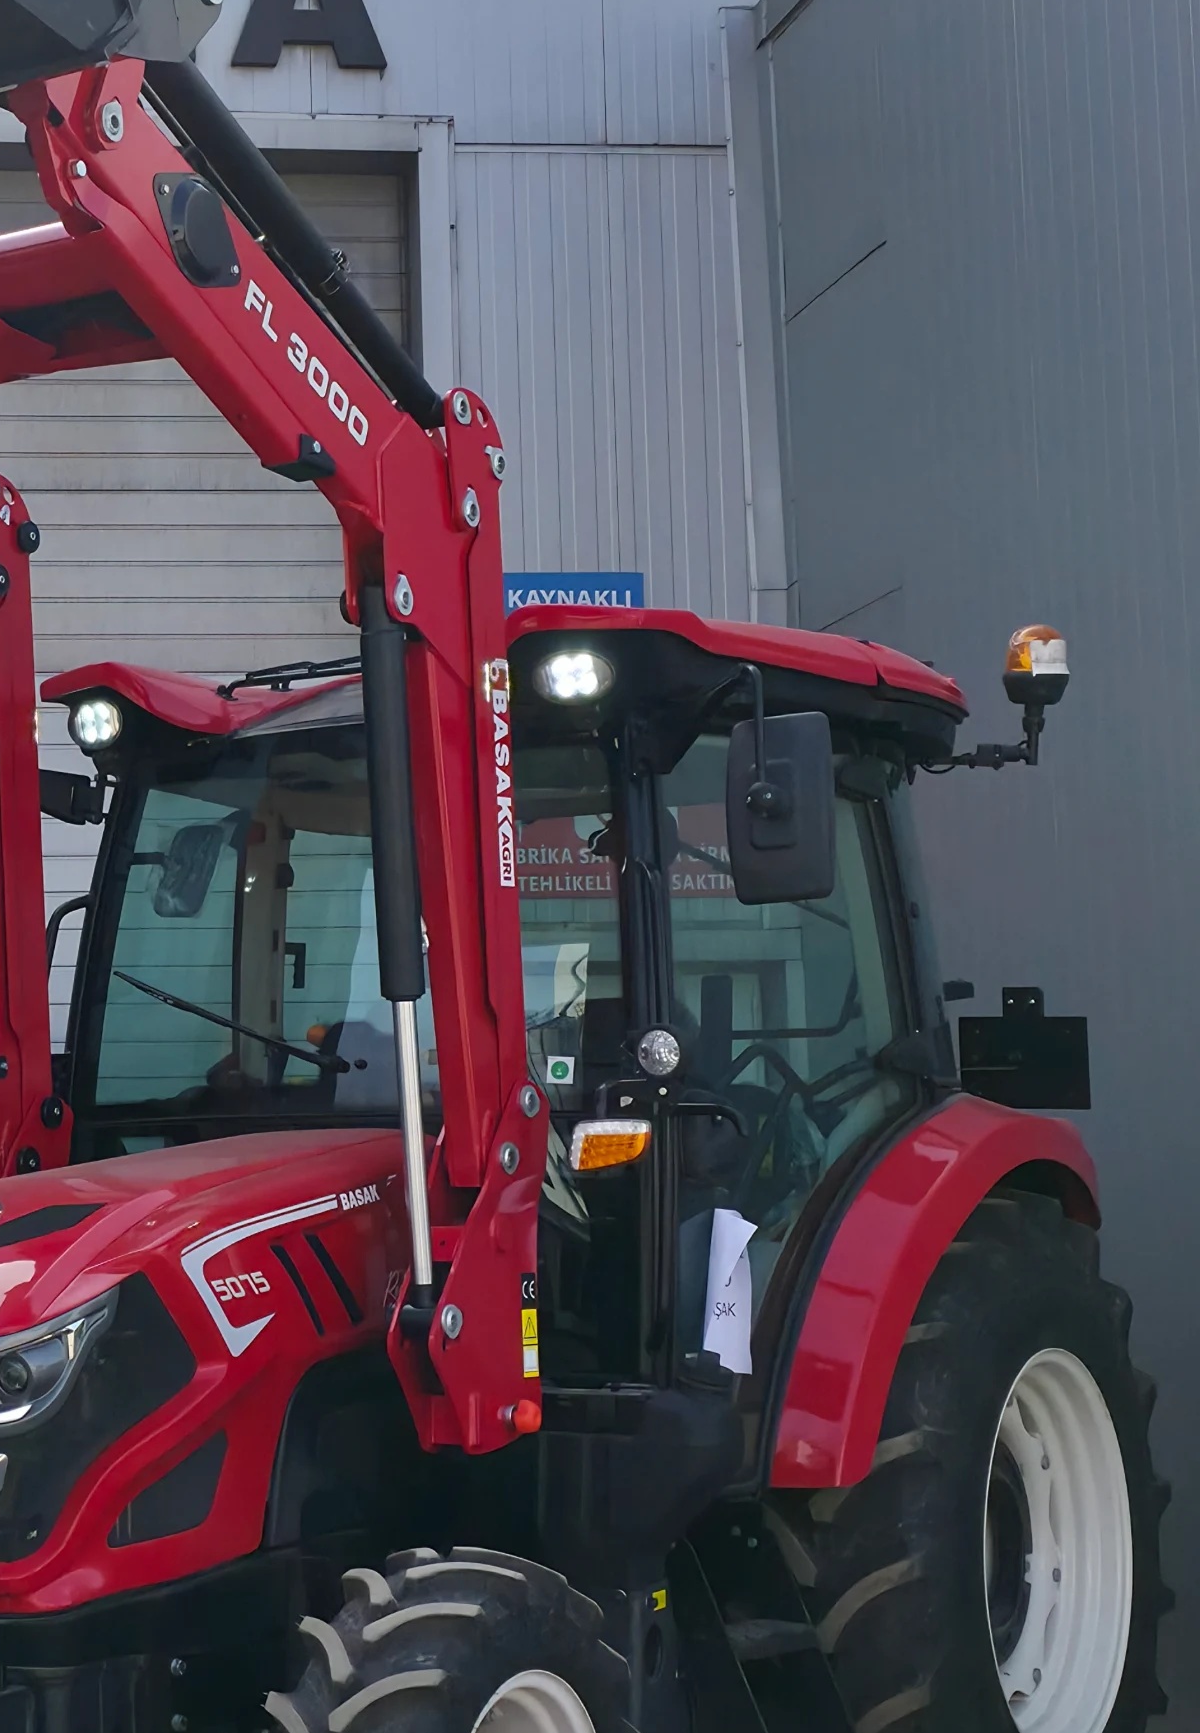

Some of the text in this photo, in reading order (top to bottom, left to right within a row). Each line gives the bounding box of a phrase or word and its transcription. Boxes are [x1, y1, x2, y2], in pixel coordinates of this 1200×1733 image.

[244, 279, 370, 447] FL 3000
[507, 589, 632, 608] KAYNAKLI
[516, 844, 574, 865] BRİKA
[517, 871, 612, 892] TEHLİKELİ
[339, 1184, 381, 1211] BASAK
[211, 1271, 271, 1302] 5075
[713, 1302, 737, 1320] ŞAK
